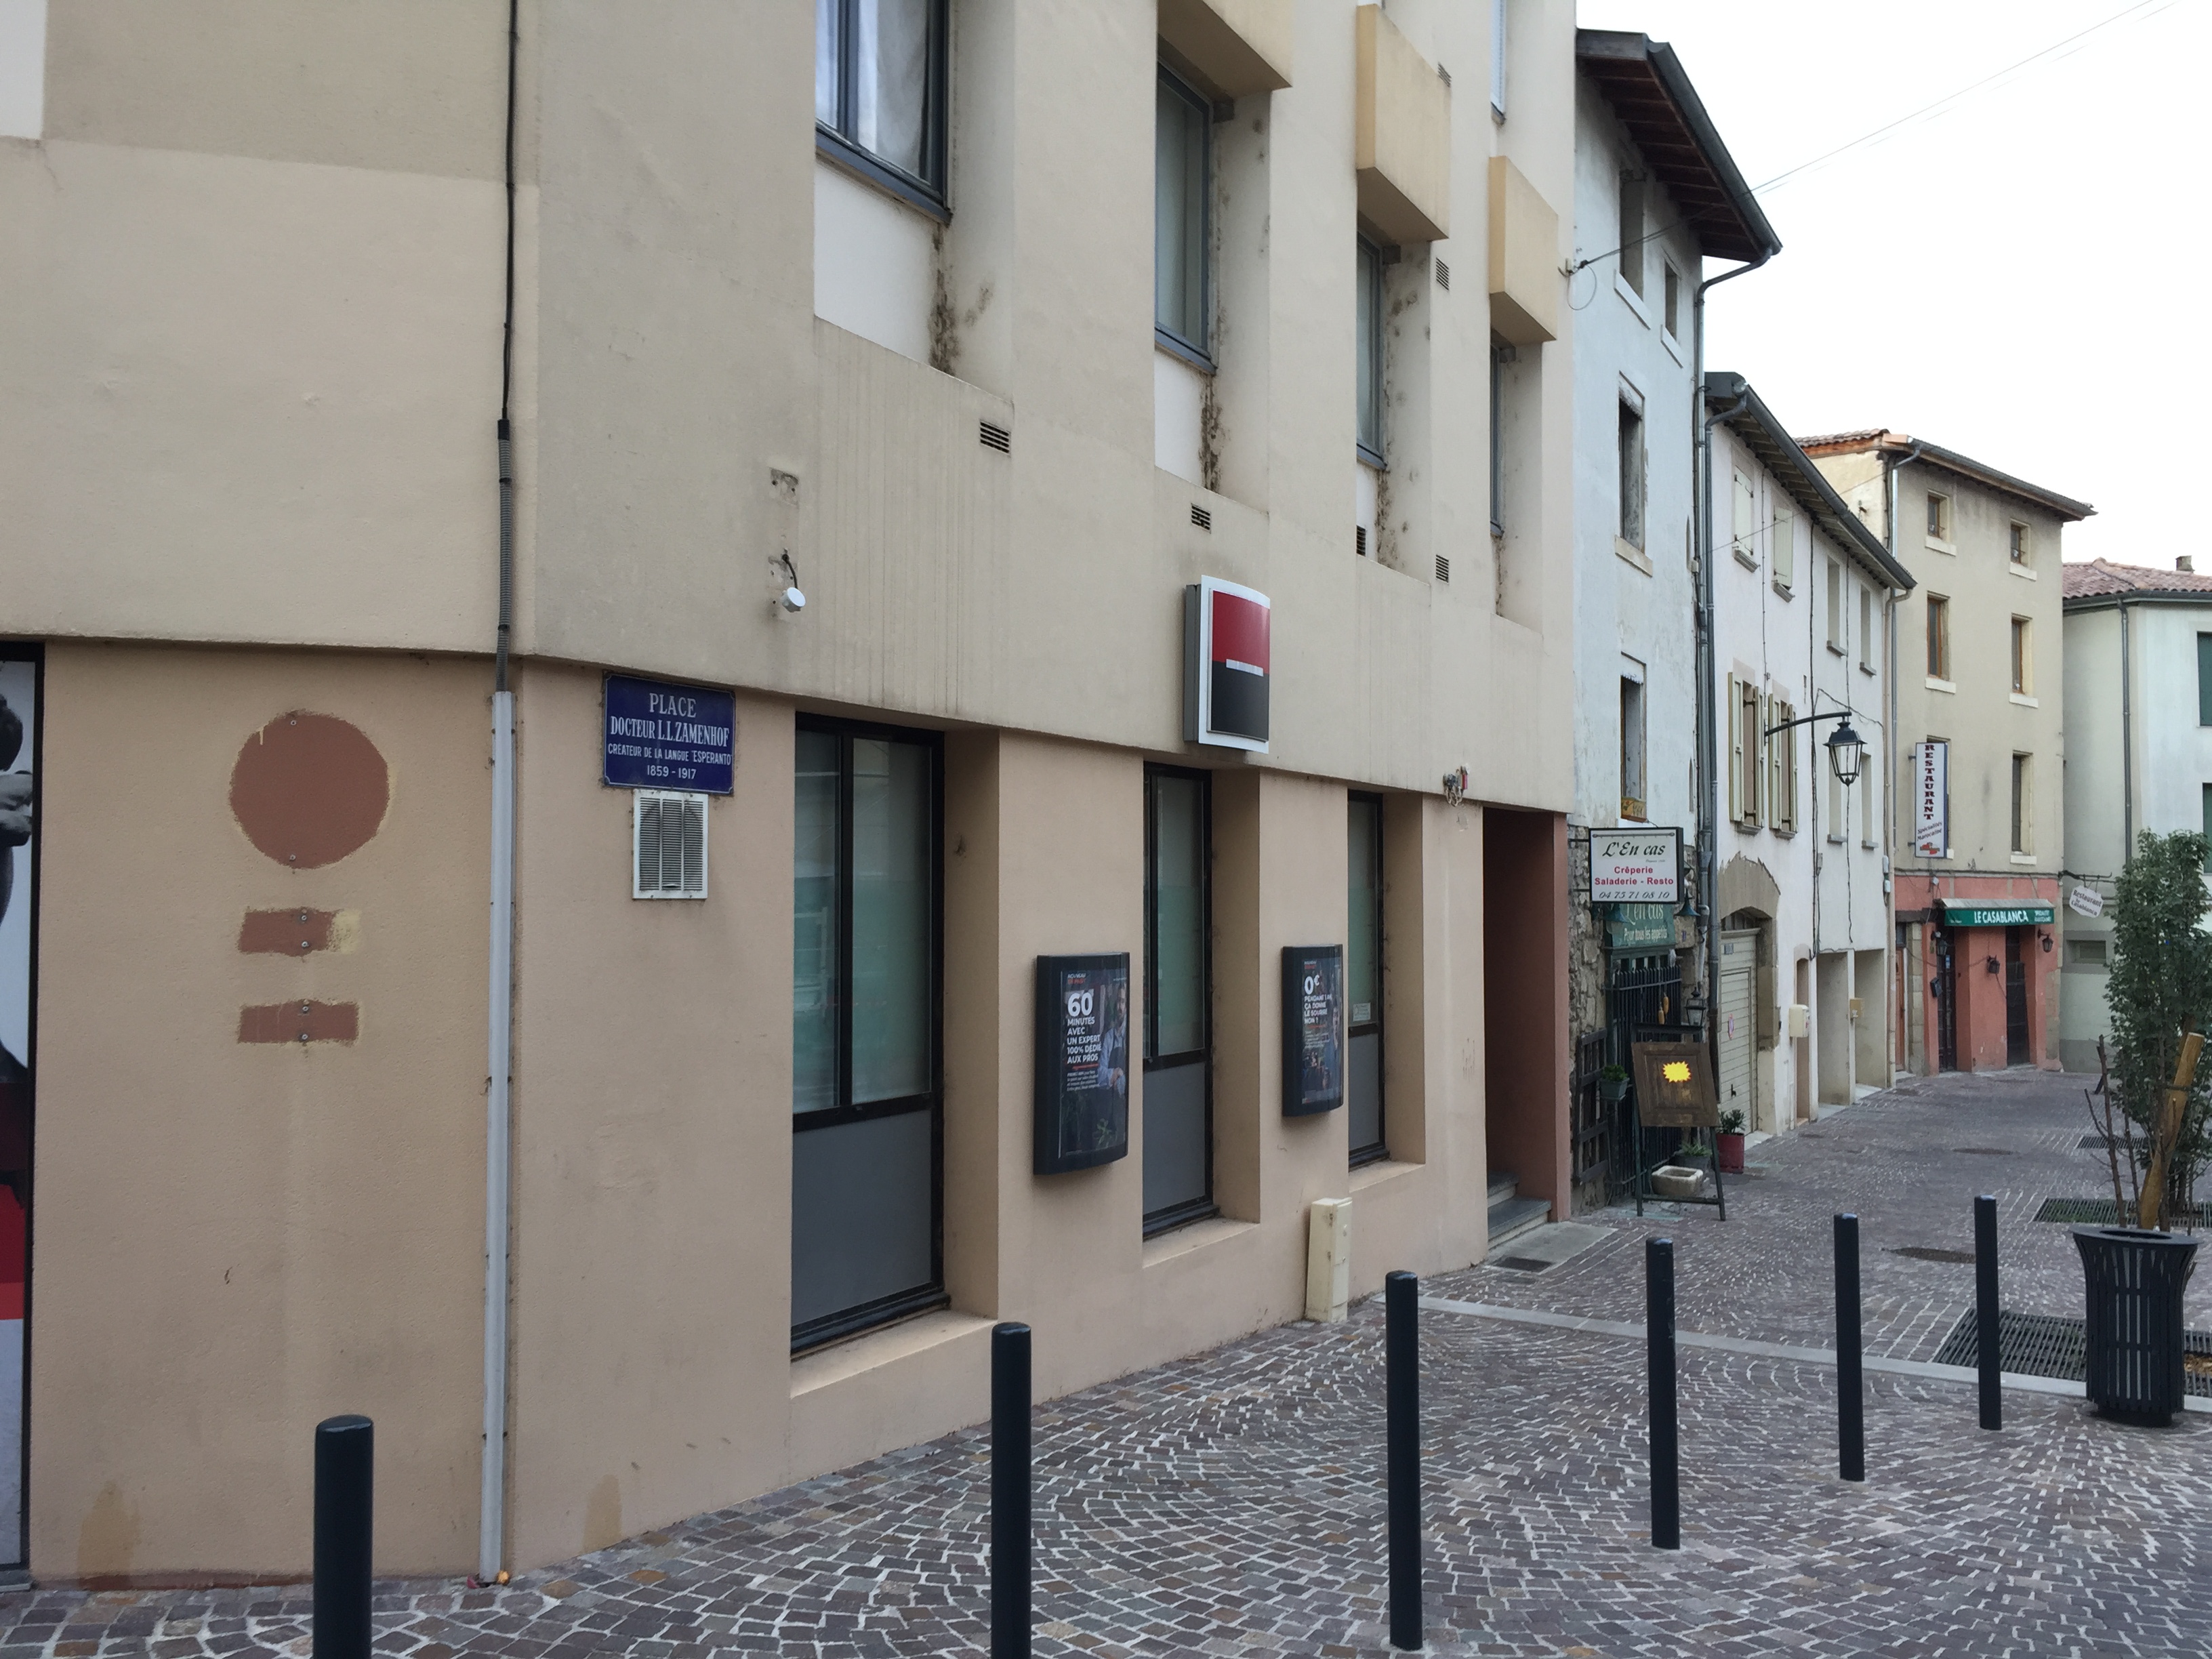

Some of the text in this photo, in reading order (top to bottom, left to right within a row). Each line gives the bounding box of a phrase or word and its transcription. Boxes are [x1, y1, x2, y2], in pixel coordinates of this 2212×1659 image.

[649, 693, 696, 718] PLACE
[611, 716, 655, 739] DOCTEUR
[644, 747, 652, 758] DE
[655, 748, 663, 760] LA
[665, 749, 689, 762] LANGUE
[647, 765, 669, 777] 1859
[678, 768, 696, 779] 1917
[1924, 745, 1935, 820] RESTAURANT
[1602, 841, 1666, 857] L'En cas
[1614, 866, 1654, 875] Crêperie
[1594, 877, 1637, 885] Saladerie
[1647, 877, 1674, 885] Resto
[2074, 889, 2102, 907] Restaurant
[1974, 911, 1982, 924] LE
[1982, 910, 2029, 924] CASABLANCA
[1305, 975, 1320, 995] 0€
[1067, 992, 1093, 1017] 60
[1067, 1017, 1095, 1026] MINUTES
[1067, 1027, 1085, 1036] AVEC
[1067, 1034, 1101, 1045] UN EXPERT
[1067, 1046, 1084, 1054] 100%
[1067, 1053, 1099, 1064] AUX PROS
